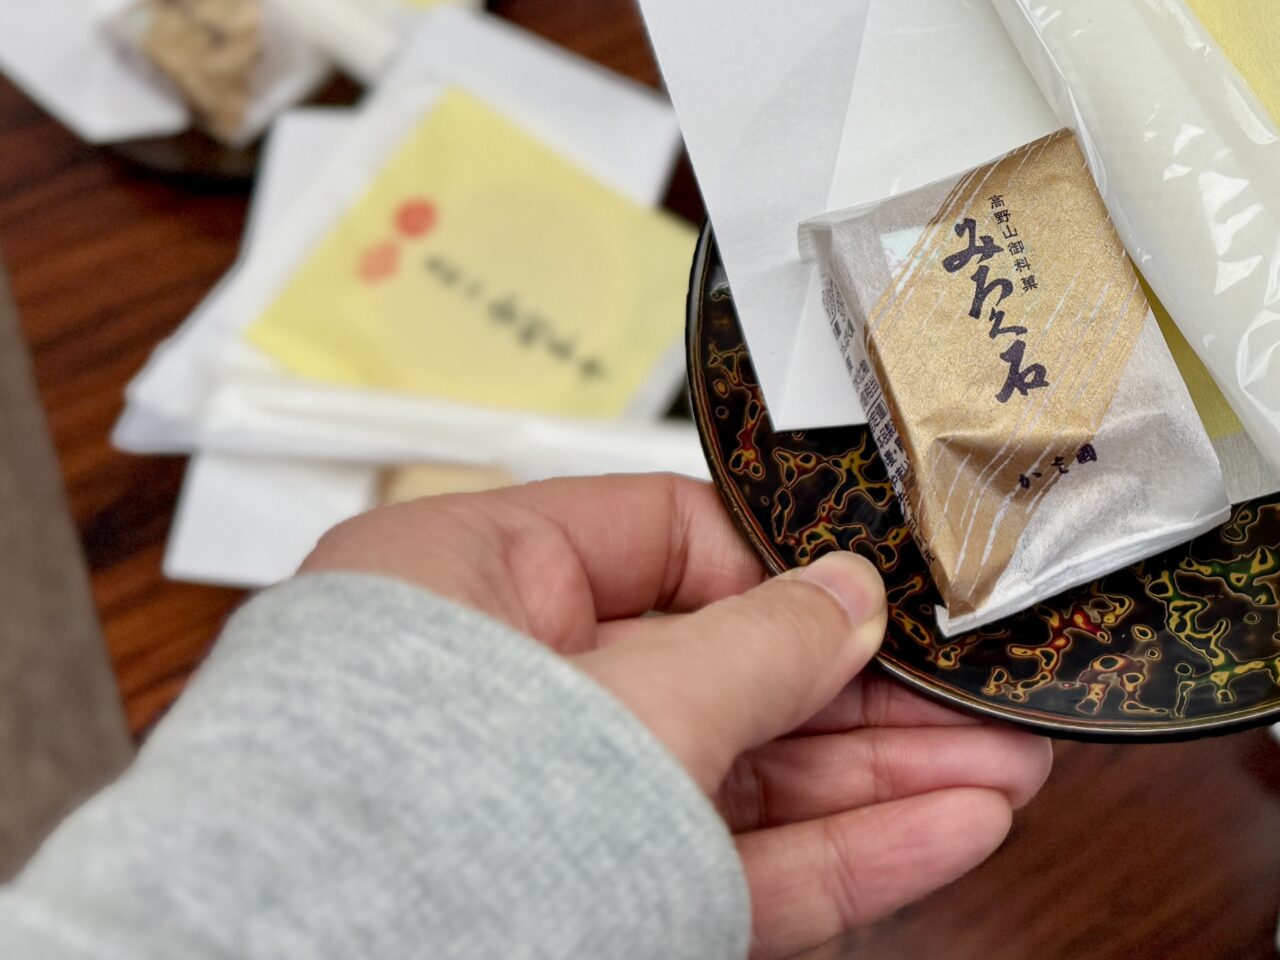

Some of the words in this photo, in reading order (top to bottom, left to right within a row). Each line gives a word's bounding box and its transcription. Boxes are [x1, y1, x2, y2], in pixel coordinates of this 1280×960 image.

[987, 194, 1039, 293] 高野山御料菓
